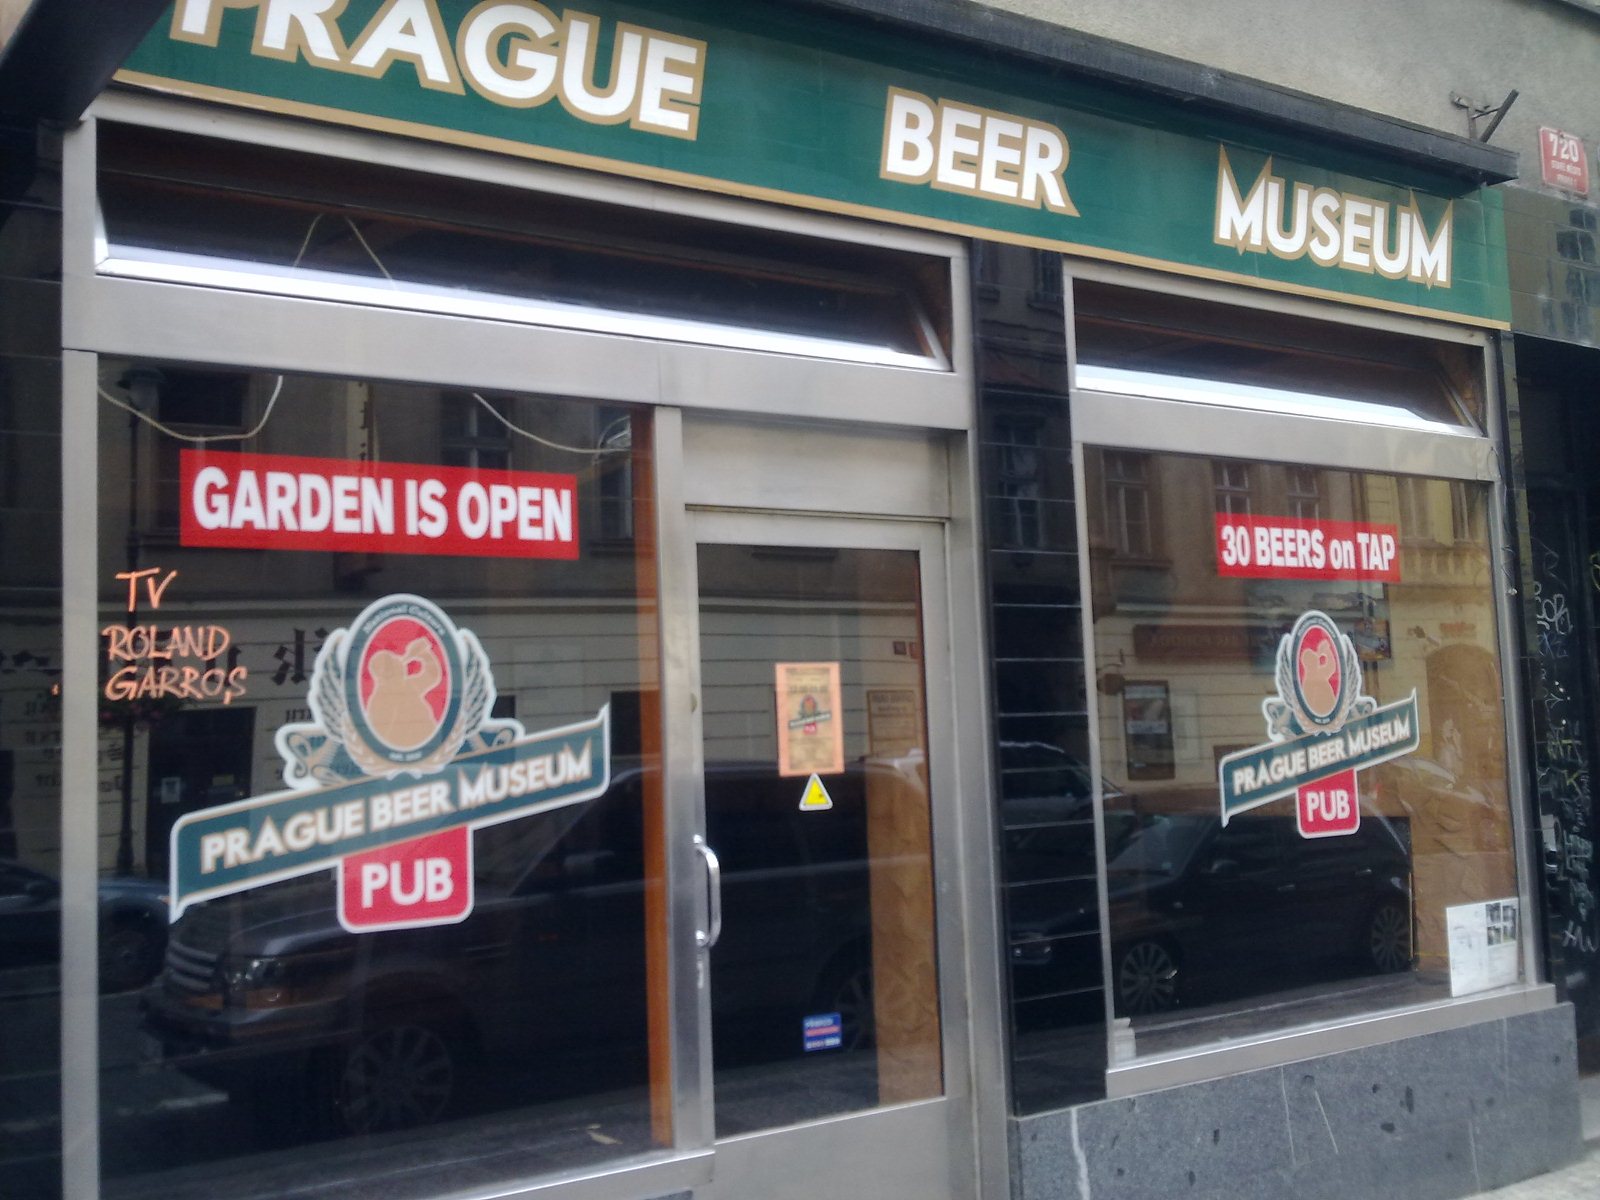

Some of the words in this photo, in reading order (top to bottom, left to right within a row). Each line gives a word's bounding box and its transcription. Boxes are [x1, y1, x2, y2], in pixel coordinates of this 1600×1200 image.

[1548, 132, 1579, 163] 720
[884, 93, 1069, 208] BEER
[1217, 158, 1450, 285] MUSEUM
[192, 466, 395, 535] GARDEN
[405, 478, 448, 538] IS
[457, 481, 573, 542] OPEN
[1221, 525, 1251, 566] 30
[1254, 526, 1326, 569] BEERS
[1329, 539, 1356, 570] on
[1356, 532, 1395, 571] TAP
[115, 567, 178, 612] TV
[101, 624, 231, 661] ROLAND
[1233, 748, 1308, 796] PRAGUE
[1308, 736, 1348, 770] BEER
[1348, 712, 1411, 757] MUSEUM
[201, 799, 365, 874] PRAGUE
[369, 779, 452, 829] BEER
[458, 740, 593, 808] MUSEUM
[1306, 788, 1351, 822] PUB
[360, 857, 454, 908] PUB
